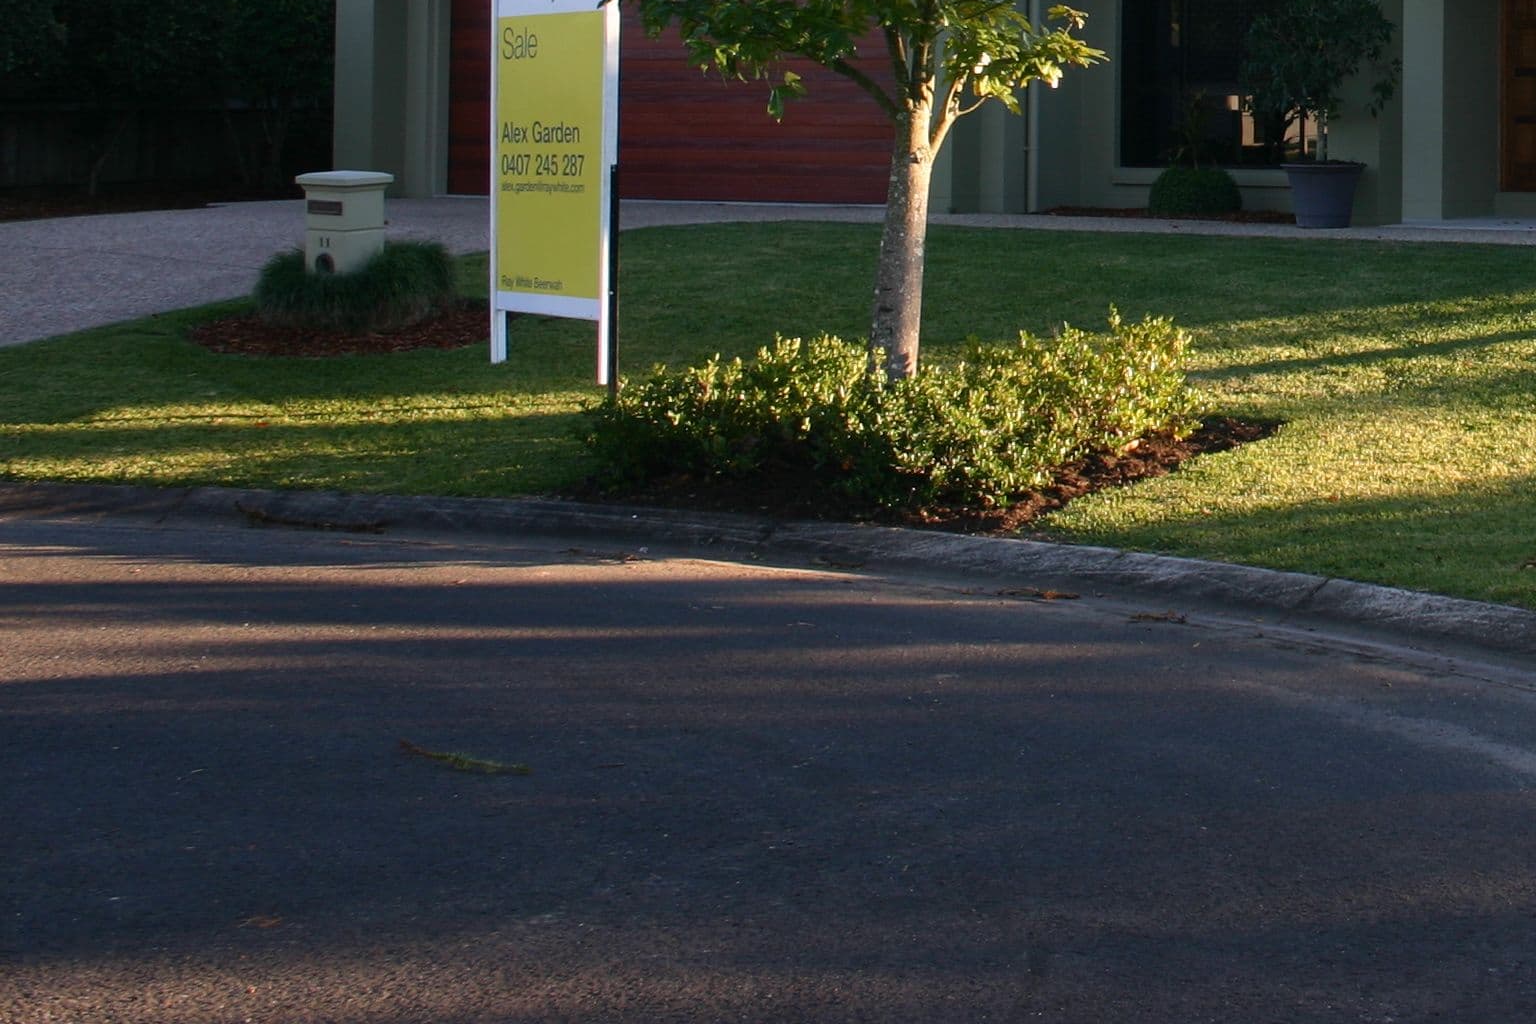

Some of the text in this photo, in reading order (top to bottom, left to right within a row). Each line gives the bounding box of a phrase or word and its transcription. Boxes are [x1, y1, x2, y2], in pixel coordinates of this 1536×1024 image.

[502, 26, 538, 60] Sale
[501, 121, 580, 143] Alex Garden
[501, 154, 585, 177] 0407 245 287
